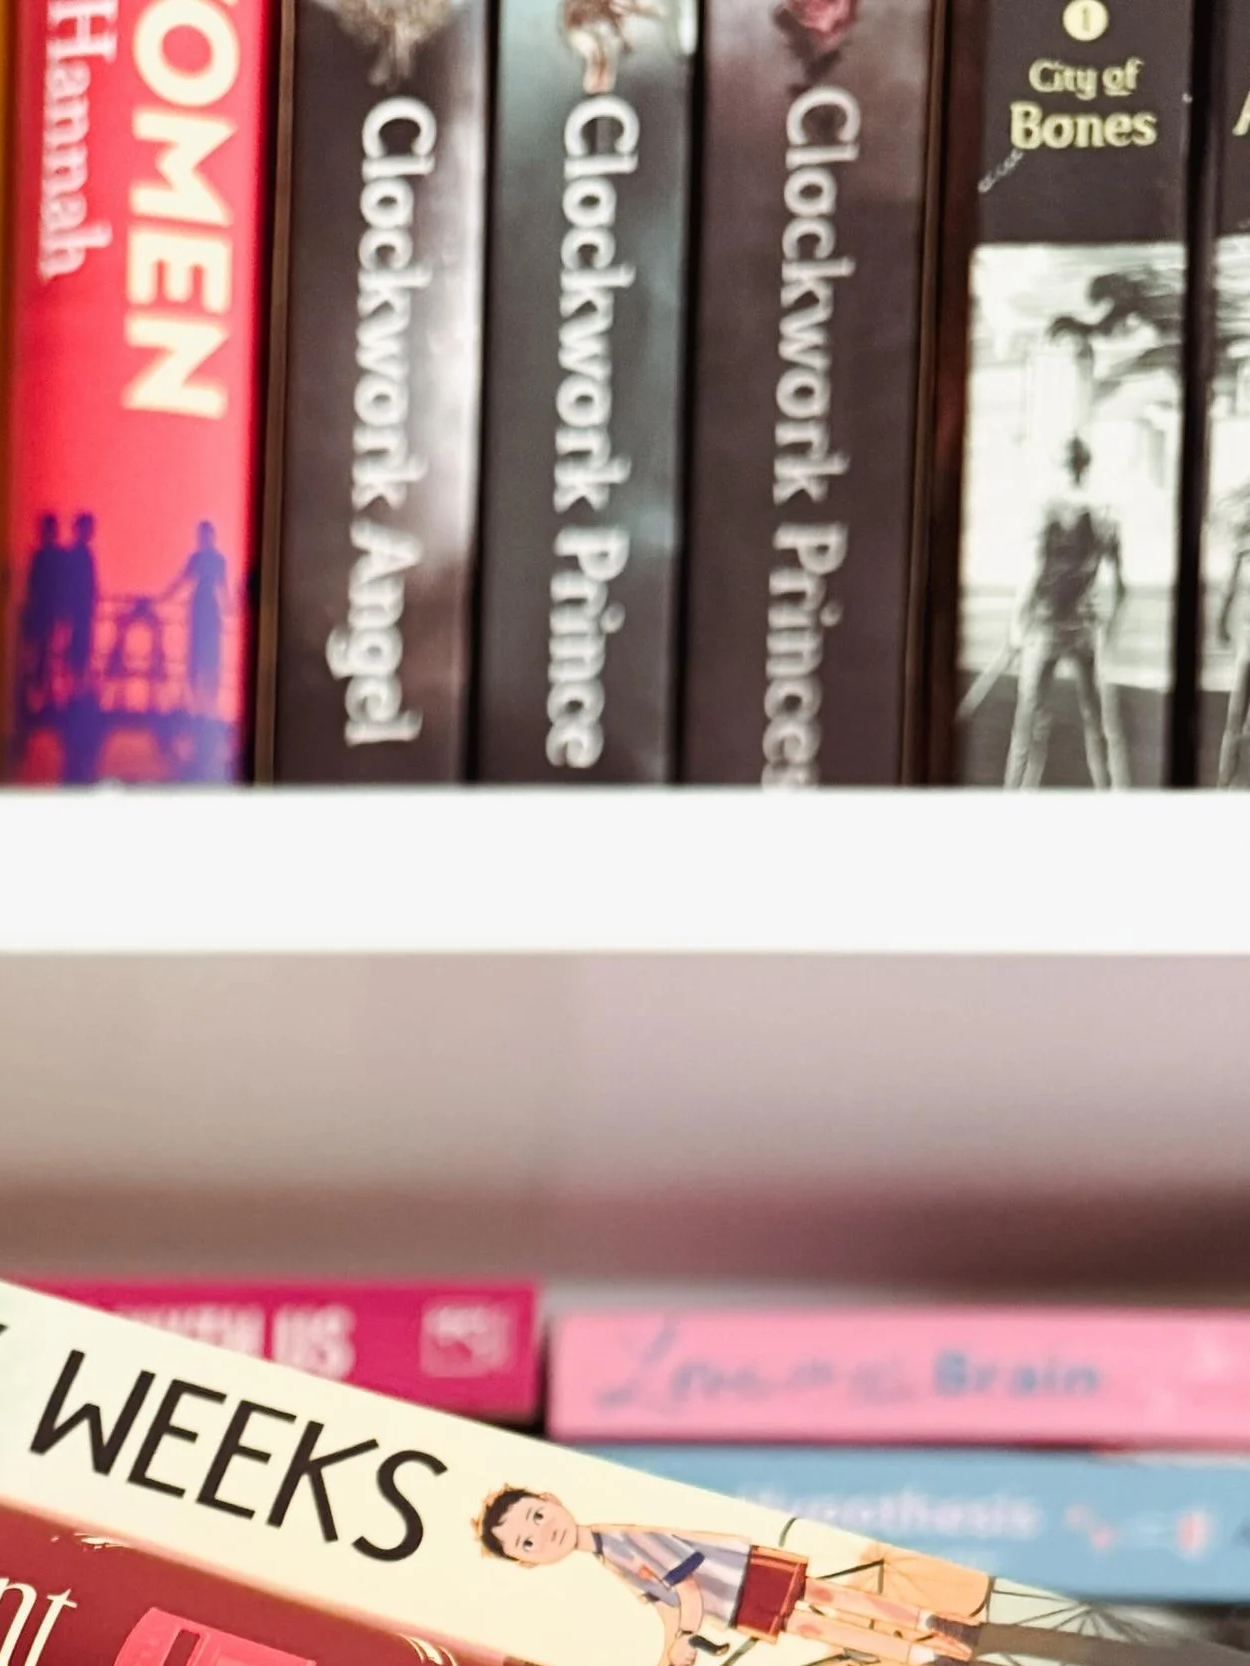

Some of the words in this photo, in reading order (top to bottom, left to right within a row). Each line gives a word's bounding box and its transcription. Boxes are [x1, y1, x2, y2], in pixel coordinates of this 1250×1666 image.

[38, 0, 117, 284] Hannah
[123, 0, 240, 420] OMEN
[1010, 101, 1158, 150] Bones
[1029, 57, 1098, 101] City
[1102, 56, 1145, 96] of
[352, 96, 437, 511] Clockwork
[553, 96, 640, 514] Clockwork
[772, 86, 861, 506] Clockwork
[326, 517, 423, 747] Angel
[546, 525, 630, 768] Prince
[29, 1349, 448, 1562] WEEKS
